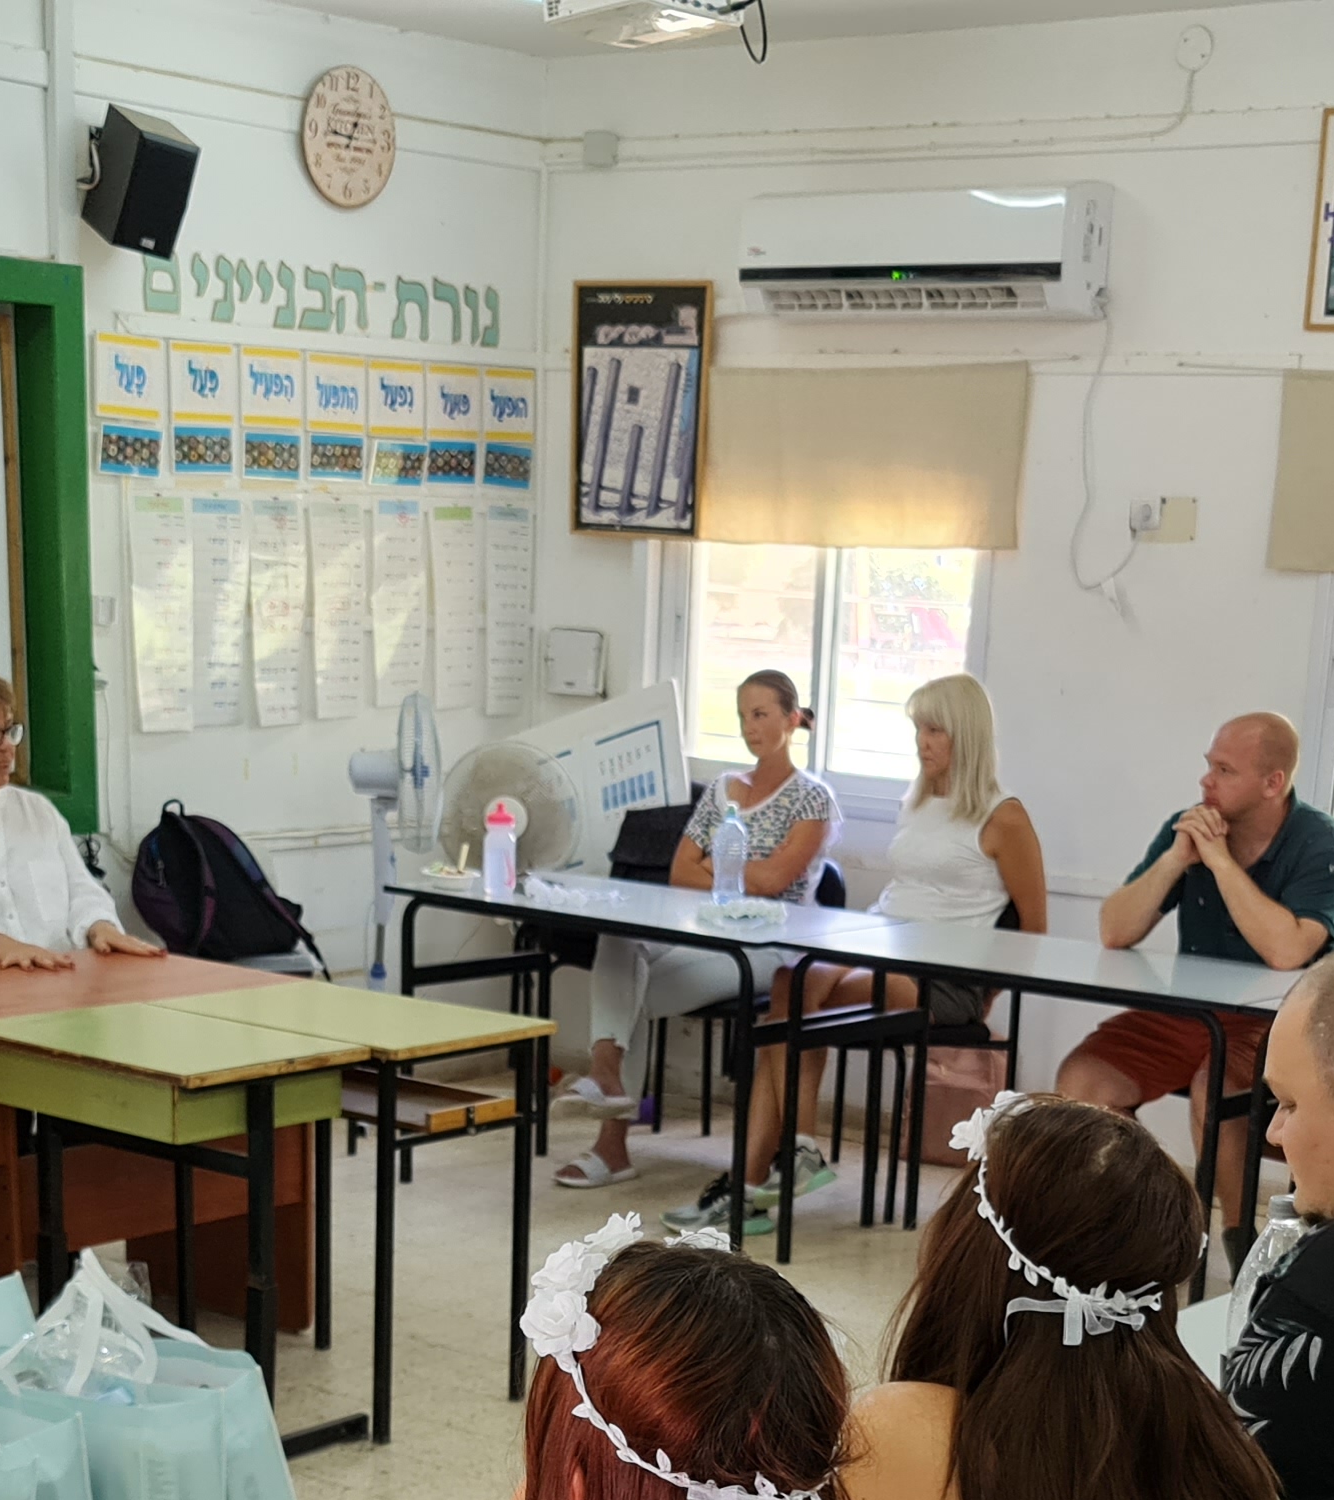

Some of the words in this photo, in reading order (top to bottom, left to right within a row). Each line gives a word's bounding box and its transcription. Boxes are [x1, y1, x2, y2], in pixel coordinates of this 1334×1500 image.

[346, 71, 360, 93] 12
[308, 119, 319, 140] 9
[380, 129, 392, 154] 3
[343, 181, 353, 199] 6
